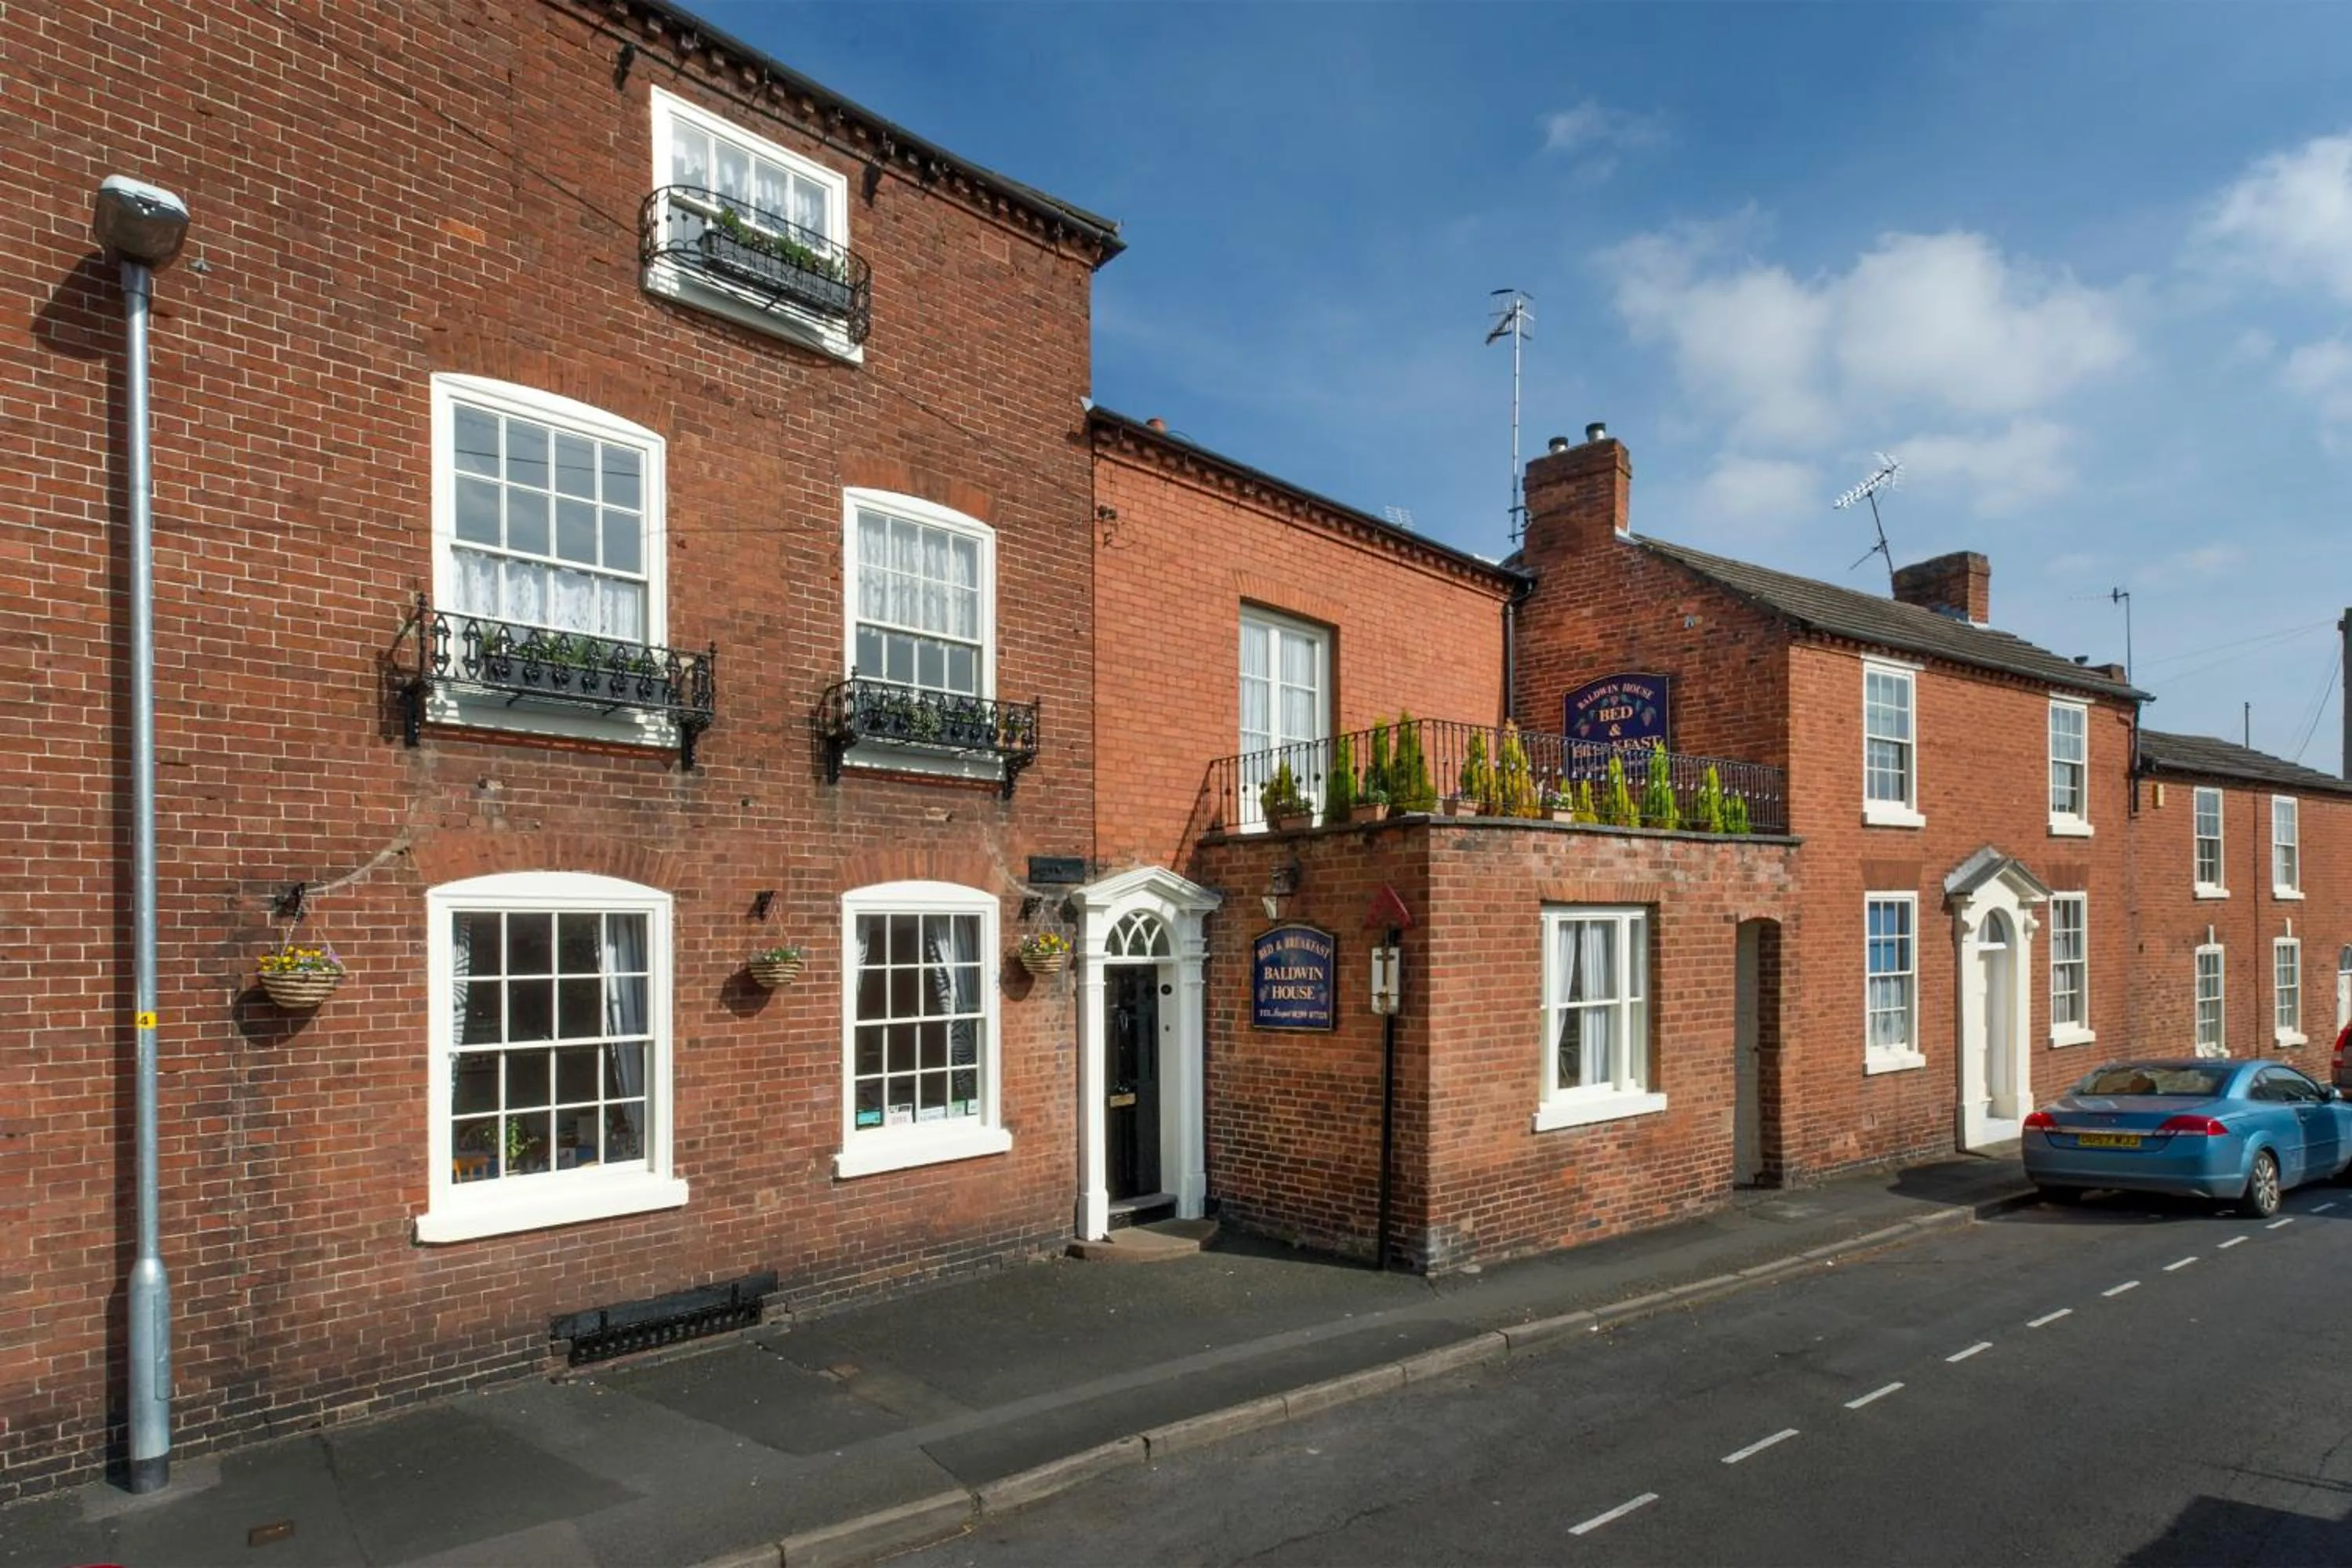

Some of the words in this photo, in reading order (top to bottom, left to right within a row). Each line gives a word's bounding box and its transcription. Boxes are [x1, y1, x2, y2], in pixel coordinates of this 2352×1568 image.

[1577, 684, 1619, 710] BALDWIN
[1622, 683, 1654, 700] HOUSE
[1599, 706, 1633, 722] BED
[1609, 723, 1621, 736] &
[1258, 943, 1274, 960] BED
[1276, 940, 1283, 951] &
[1284, 936, 1330, 960] BREAKFAST
[1264, 967, 1324, 980] BALDWIN
[1272, 985, 1316, 1000] HOUSE
[140, 1015, 150, 1025] 4
